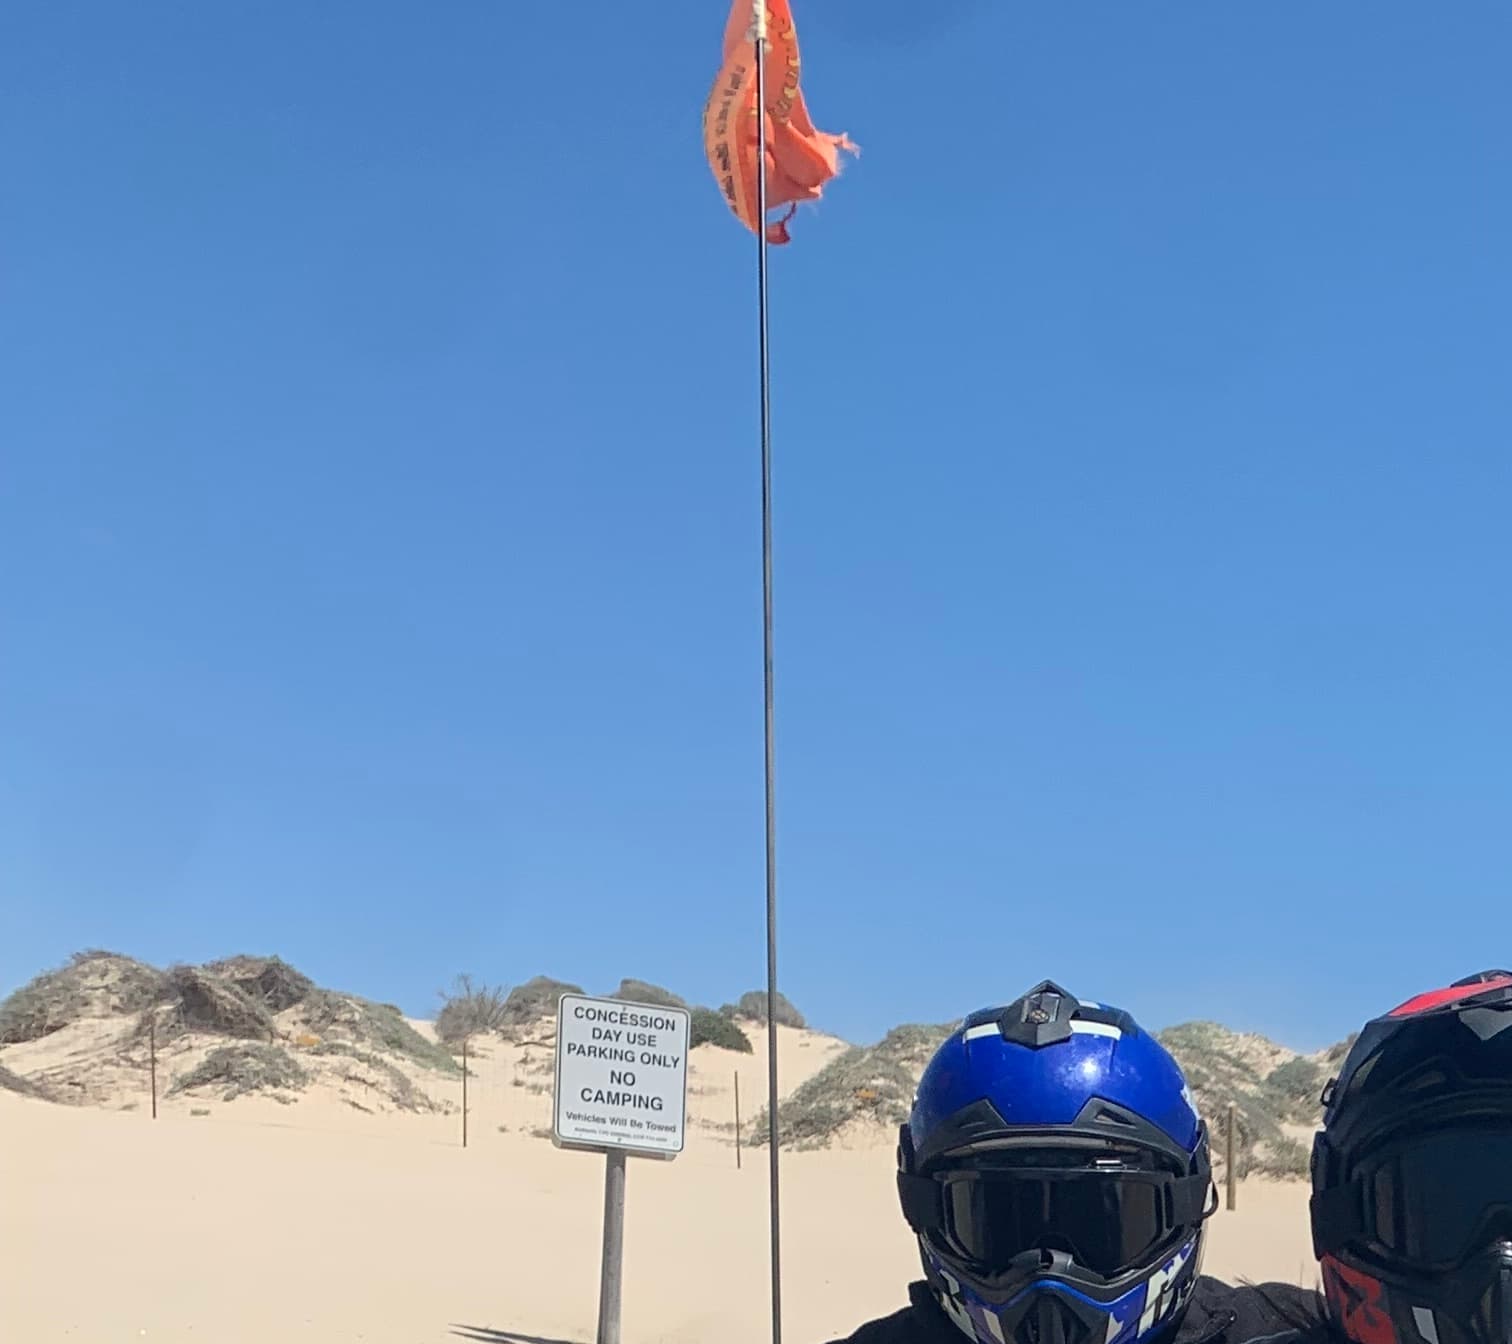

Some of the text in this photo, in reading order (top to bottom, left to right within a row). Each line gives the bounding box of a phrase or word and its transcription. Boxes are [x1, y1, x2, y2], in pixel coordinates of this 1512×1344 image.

[574, 1006, 676, 1031] CONCESSION
[592, 1027, 657, 1047] DAY USE
[567, 1042, 680, 1068] PARKING ONLY
[610, 1070, 636, 1086] NO
[580, 1088, 663, 1111] CAMPING
[566, 1111, 677, 1133] Vehicles Will Be Towed
